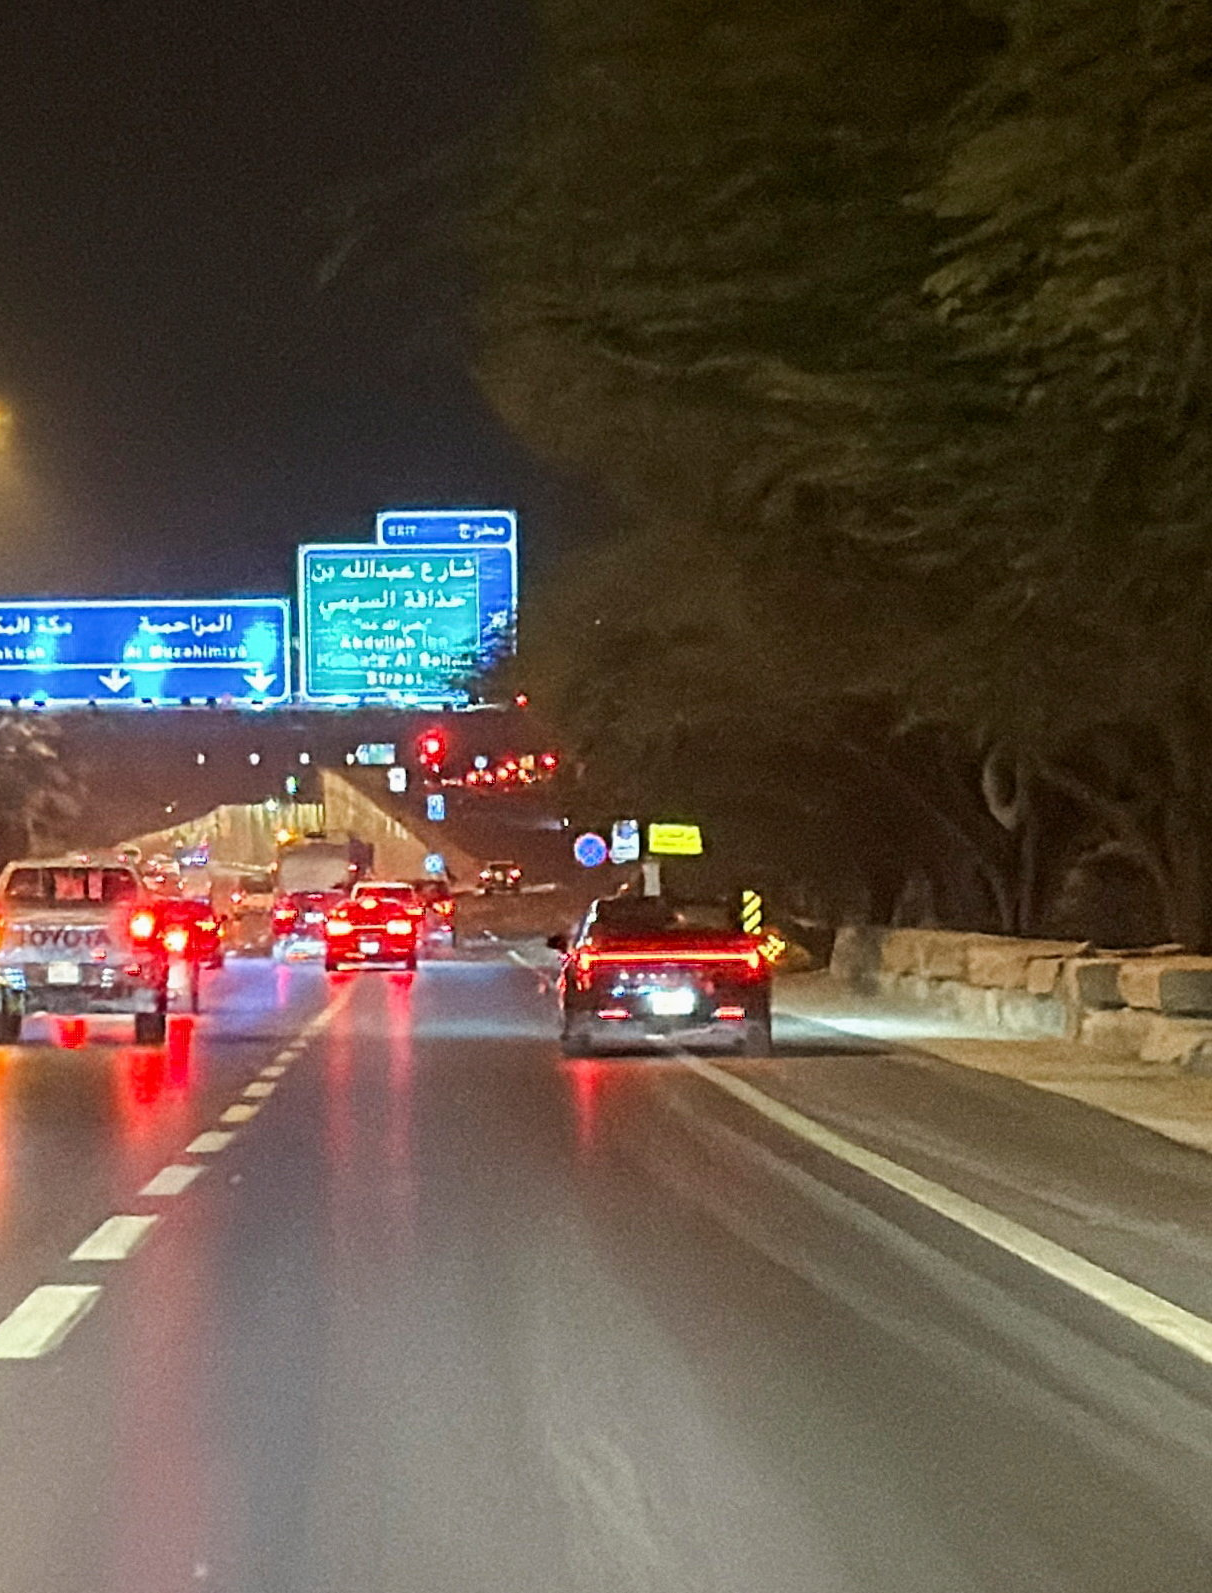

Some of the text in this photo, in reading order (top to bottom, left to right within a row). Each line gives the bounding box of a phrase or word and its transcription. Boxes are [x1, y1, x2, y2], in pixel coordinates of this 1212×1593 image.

[388, 525, 417, 536] EXIT
[459, 523, 506, 539] مخرج
[311, 559, 475, 583] شارع عبدالله بن
[35, 615, 73, 634] مكة
[138, 614, 232, 637] المزاحمية
[340, 635, 416, 649] Abdullah
[367, 670, 423, 685] Street
[17, 929, 112, 948] TOYOTA
